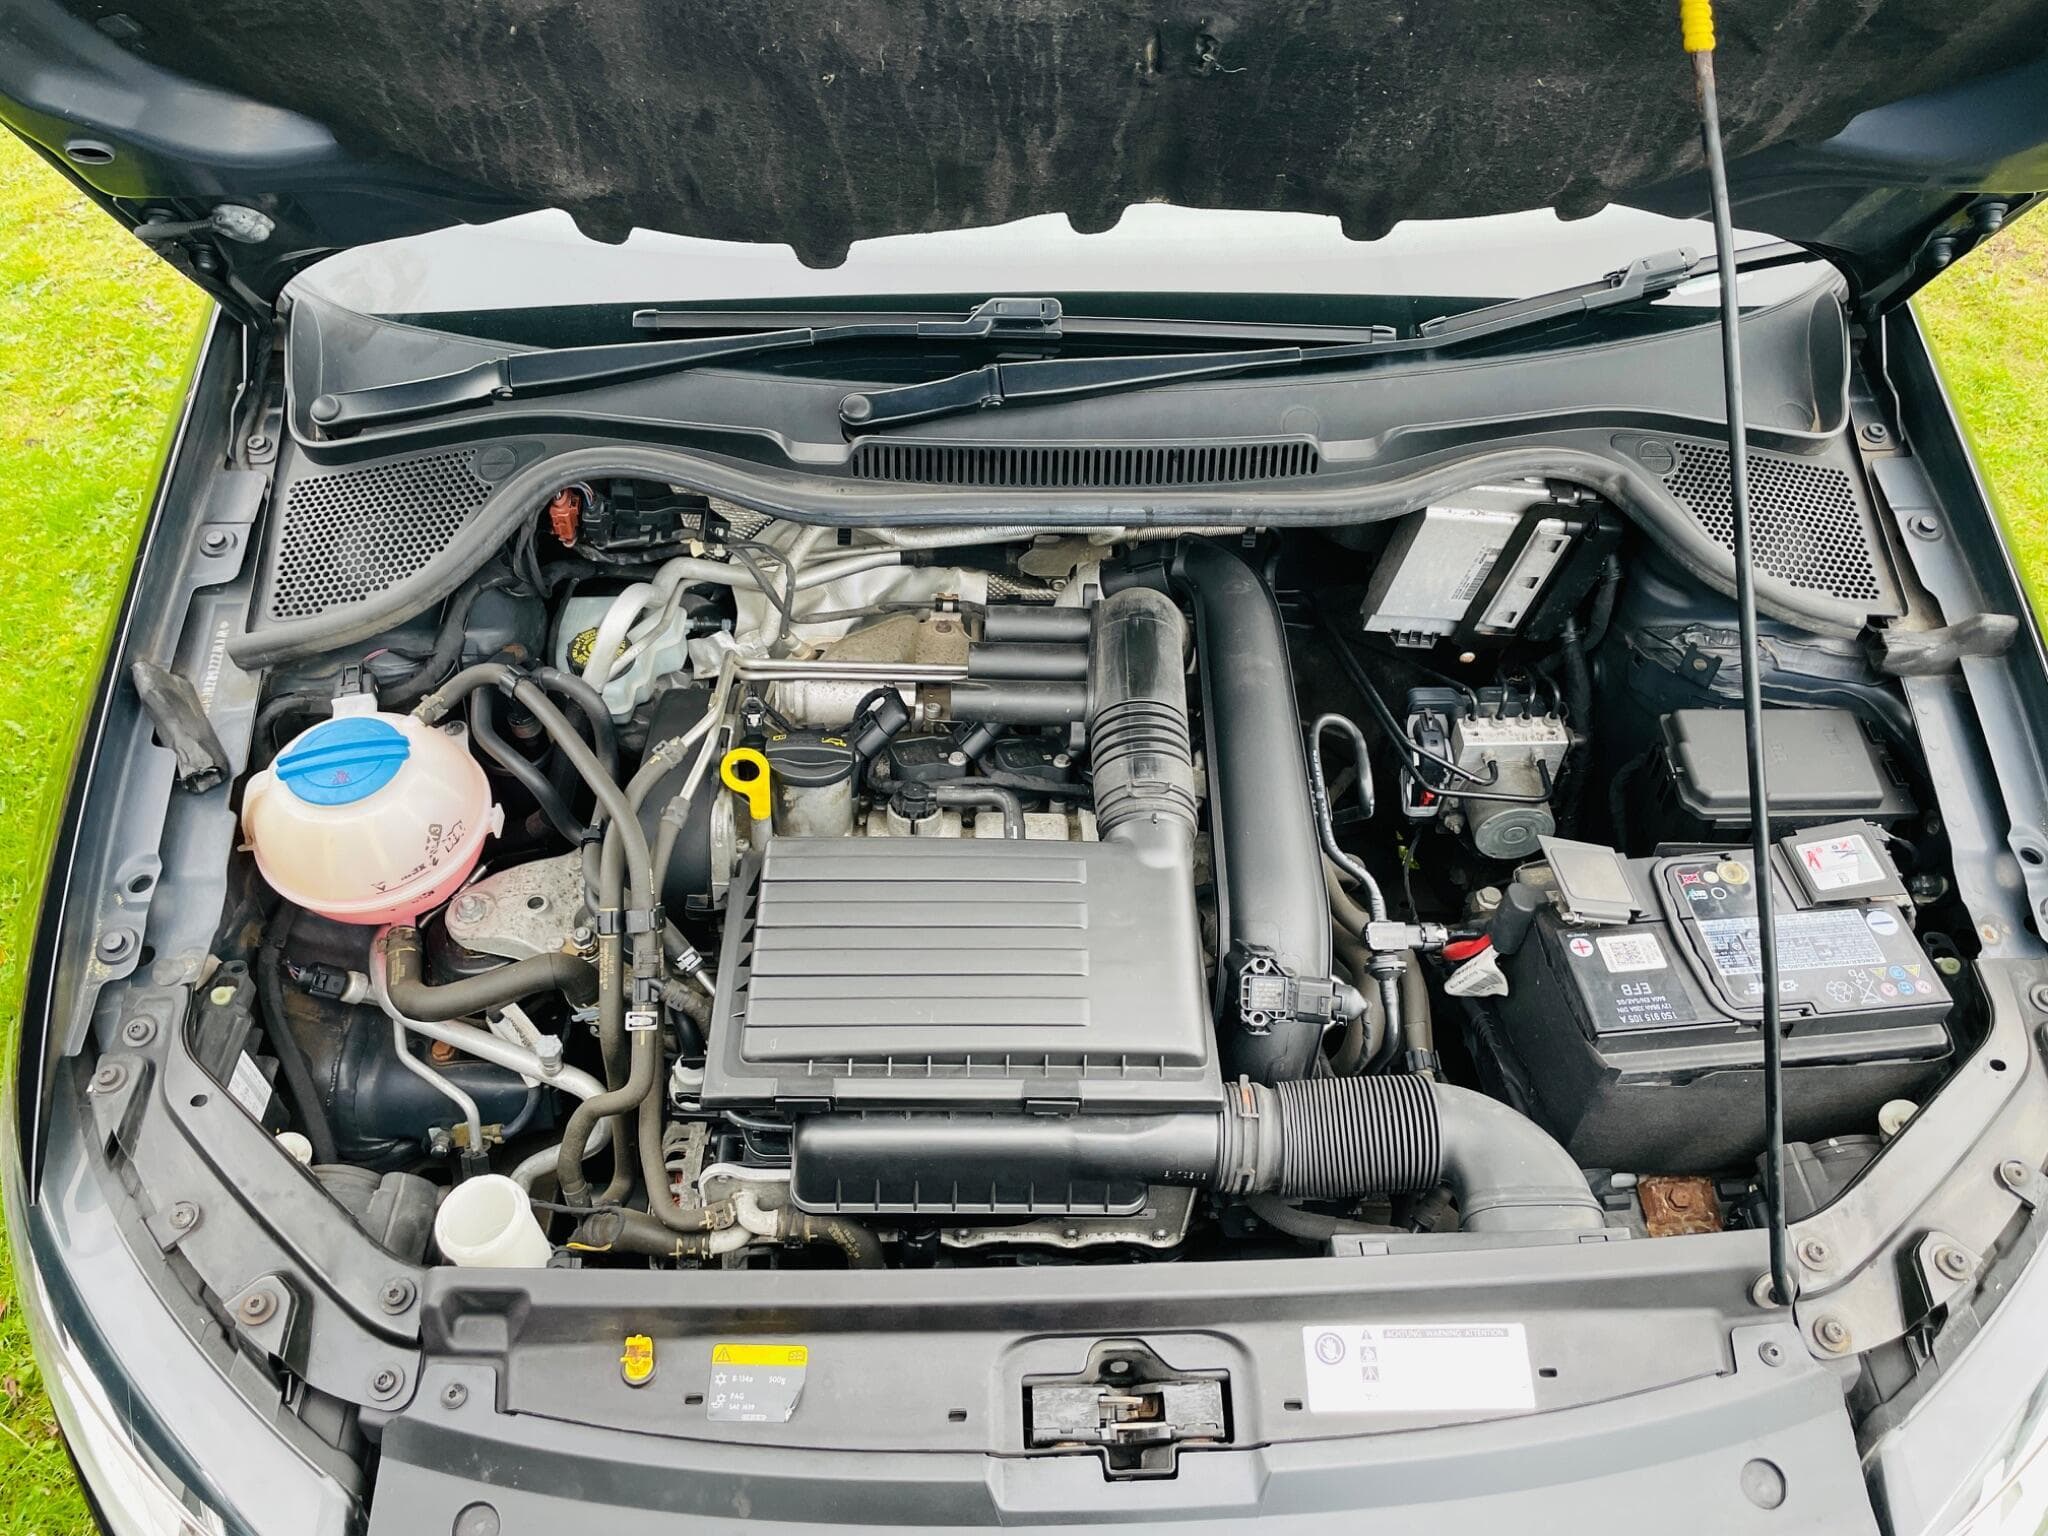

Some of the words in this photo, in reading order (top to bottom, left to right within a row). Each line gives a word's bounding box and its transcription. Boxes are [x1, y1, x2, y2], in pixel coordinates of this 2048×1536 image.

[1620, 982, 1653, 996] EFB
[1618, 1015, 1627, 1024] A
[1628, 1014, 1644, 1023] 105
[1644, 1012, 1661, 1022] 915
[1464, 1327, 1505, 1337] ATTENTION
